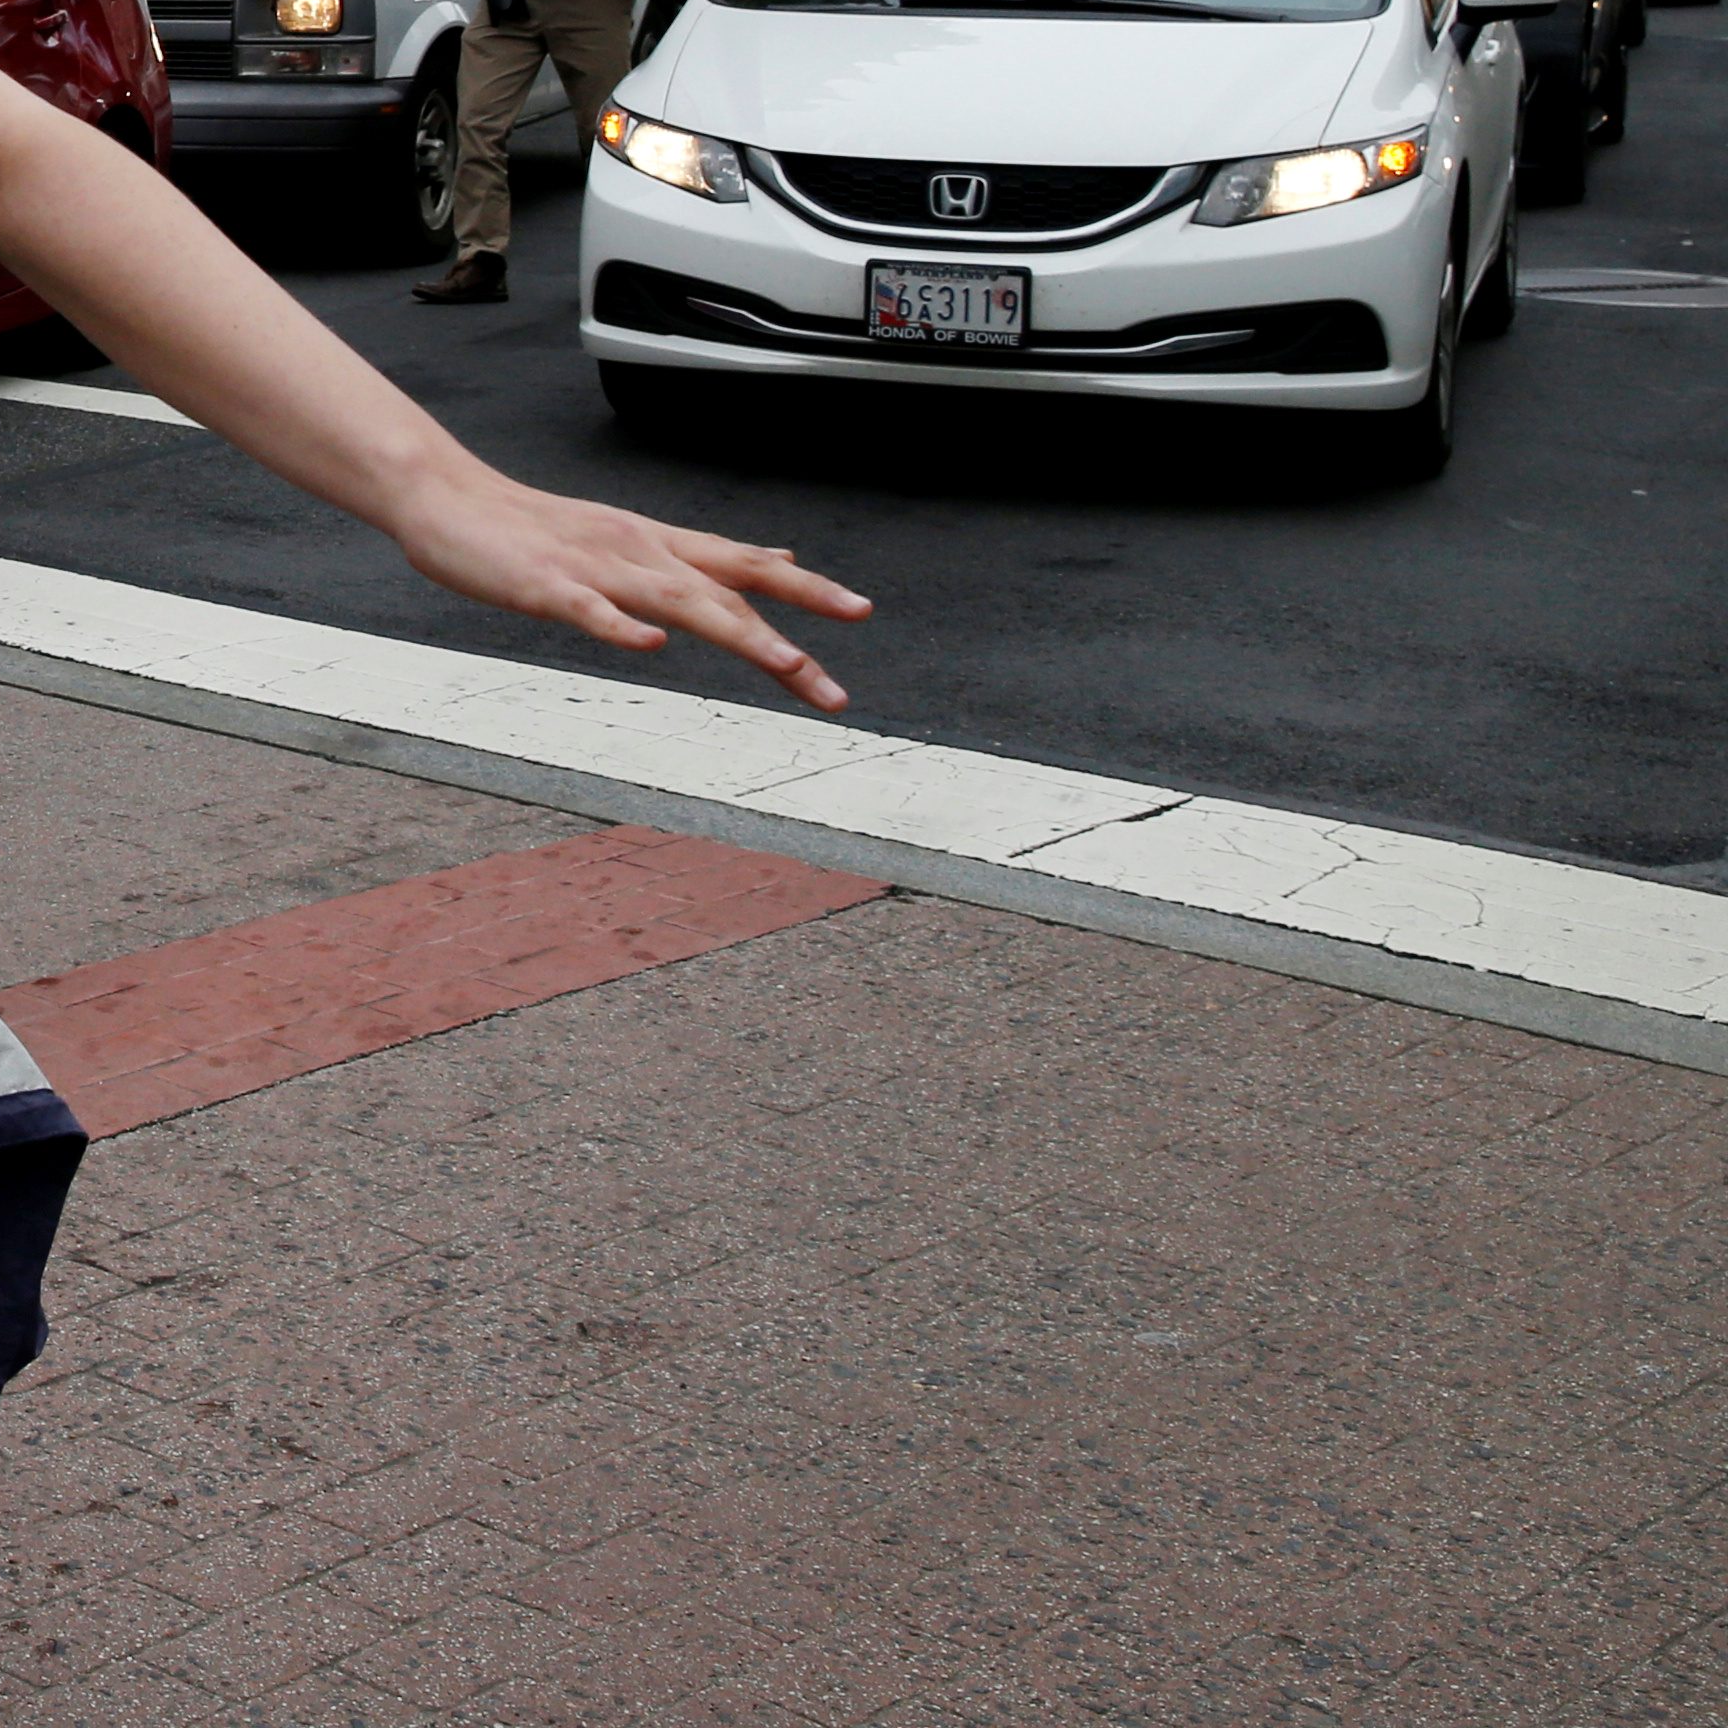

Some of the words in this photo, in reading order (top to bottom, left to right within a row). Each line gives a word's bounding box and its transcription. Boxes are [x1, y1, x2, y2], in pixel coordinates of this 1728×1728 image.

[869, 326, 926, 341] HONDA
[934, 329, 957, 342] OF
[964, 332, 1020, 346] BOWIE
